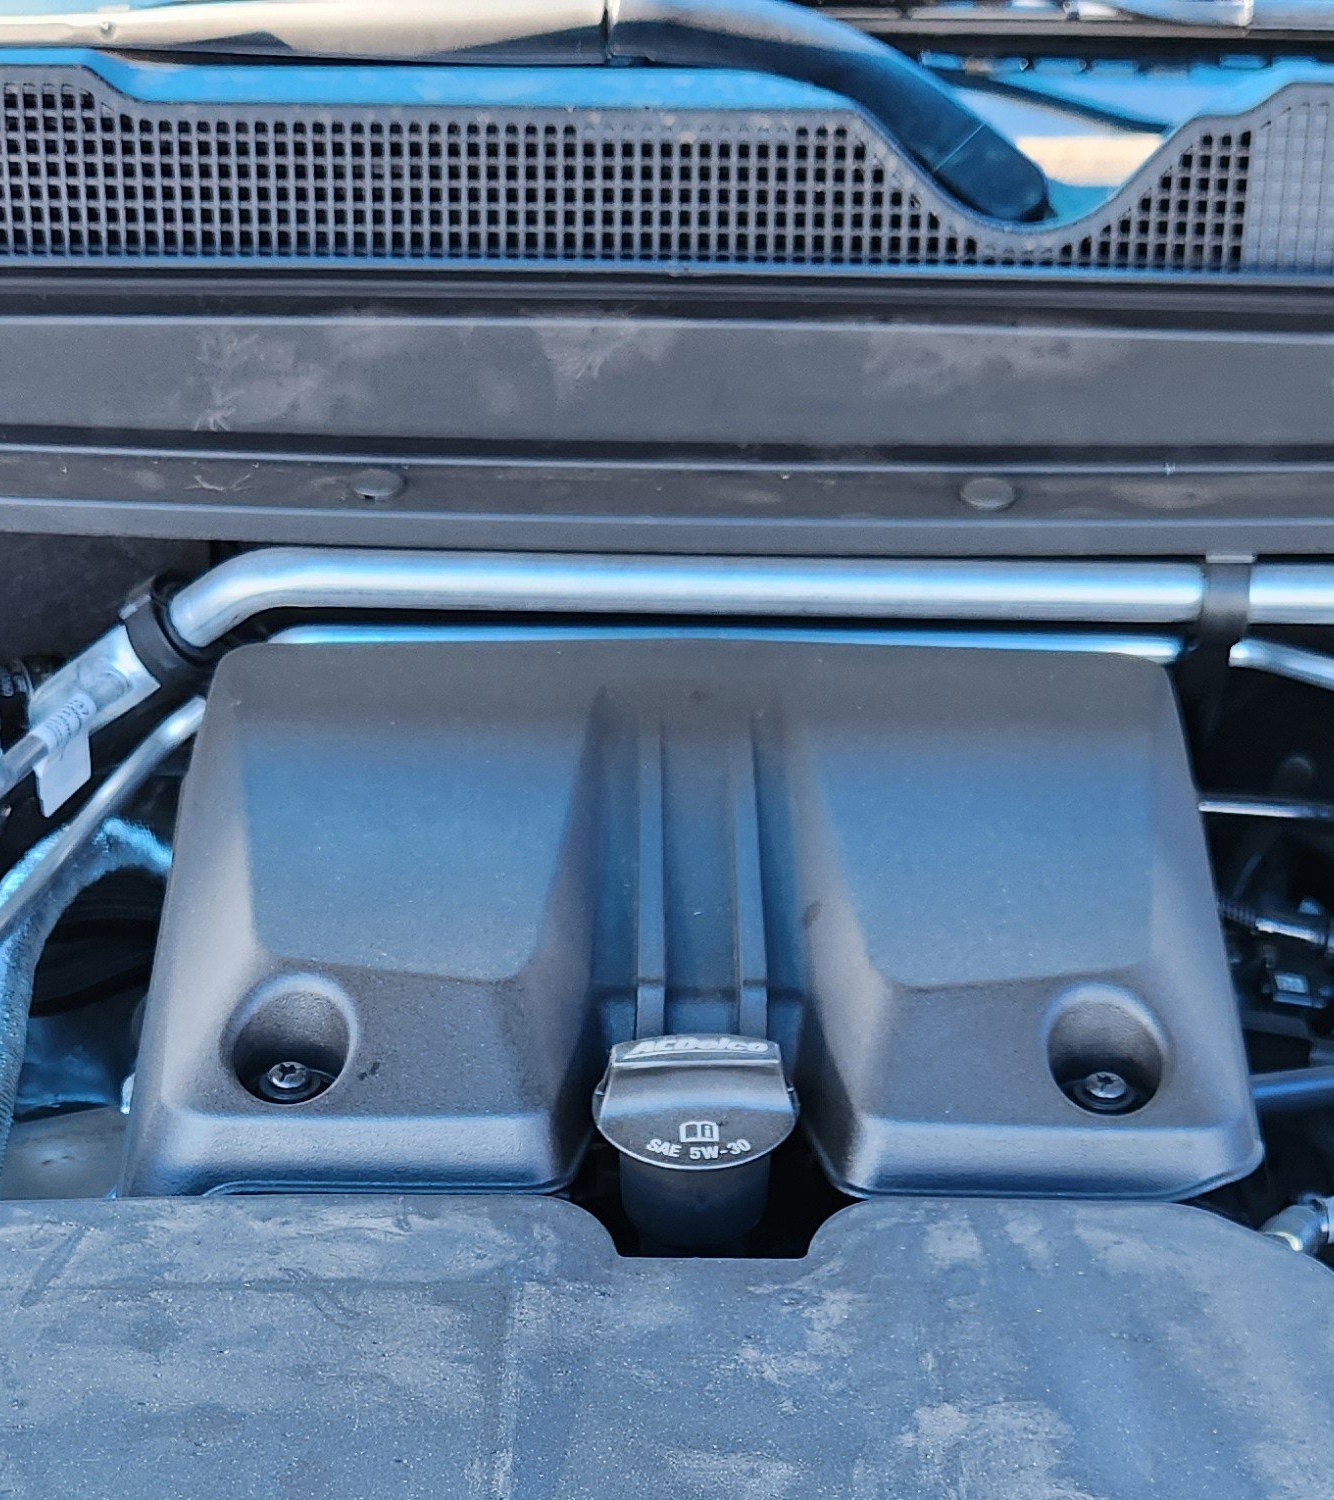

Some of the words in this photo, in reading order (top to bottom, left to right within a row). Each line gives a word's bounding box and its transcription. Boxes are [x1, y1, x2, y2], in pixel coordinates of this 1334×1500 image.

[625, 1037, 769, 1056] ACDelco
[646, 1138, 682, 1157] SAE
[689, 1138, 752, 1160] 5W-30
